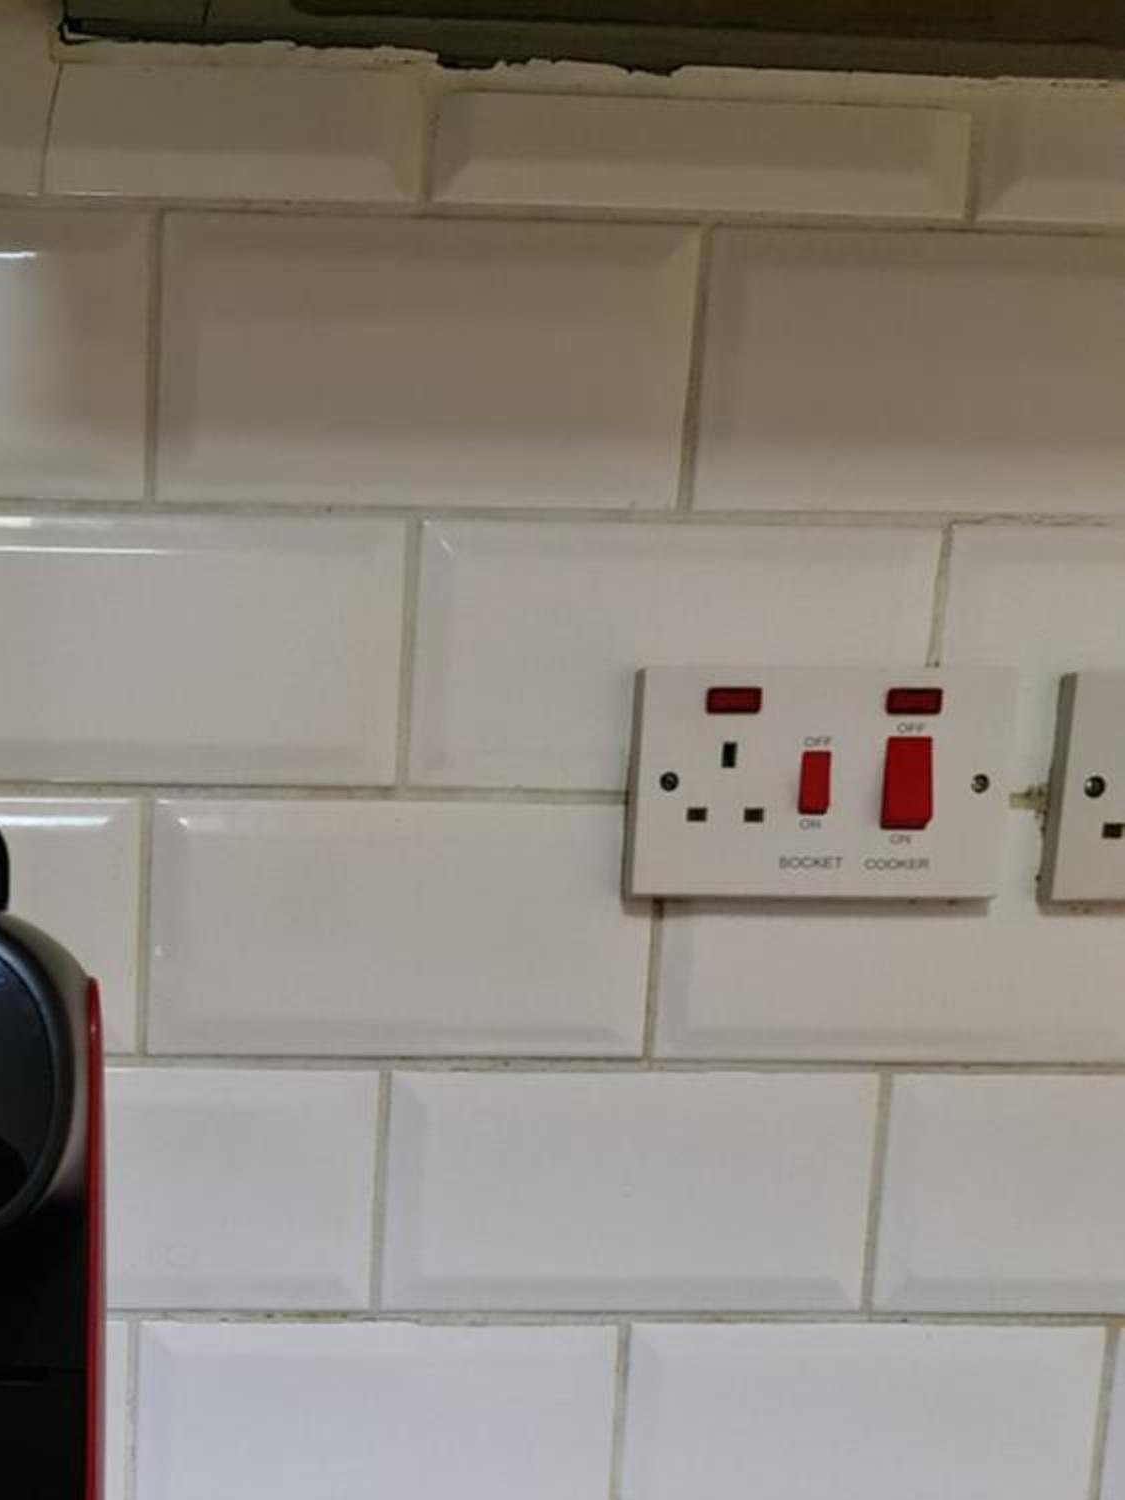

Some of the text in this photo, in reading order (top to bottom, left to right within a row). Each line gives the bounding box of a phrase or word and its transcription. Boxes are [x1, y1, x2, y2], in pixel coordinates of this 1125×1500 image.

[896, 722, 925, 734] OFF
[803, 736, 831, 747] OFF
[799, 818, 822, 830] ON
[889, 833, 912, 845] ON
[778, 856, 930, 871] SOCKET COOKER
